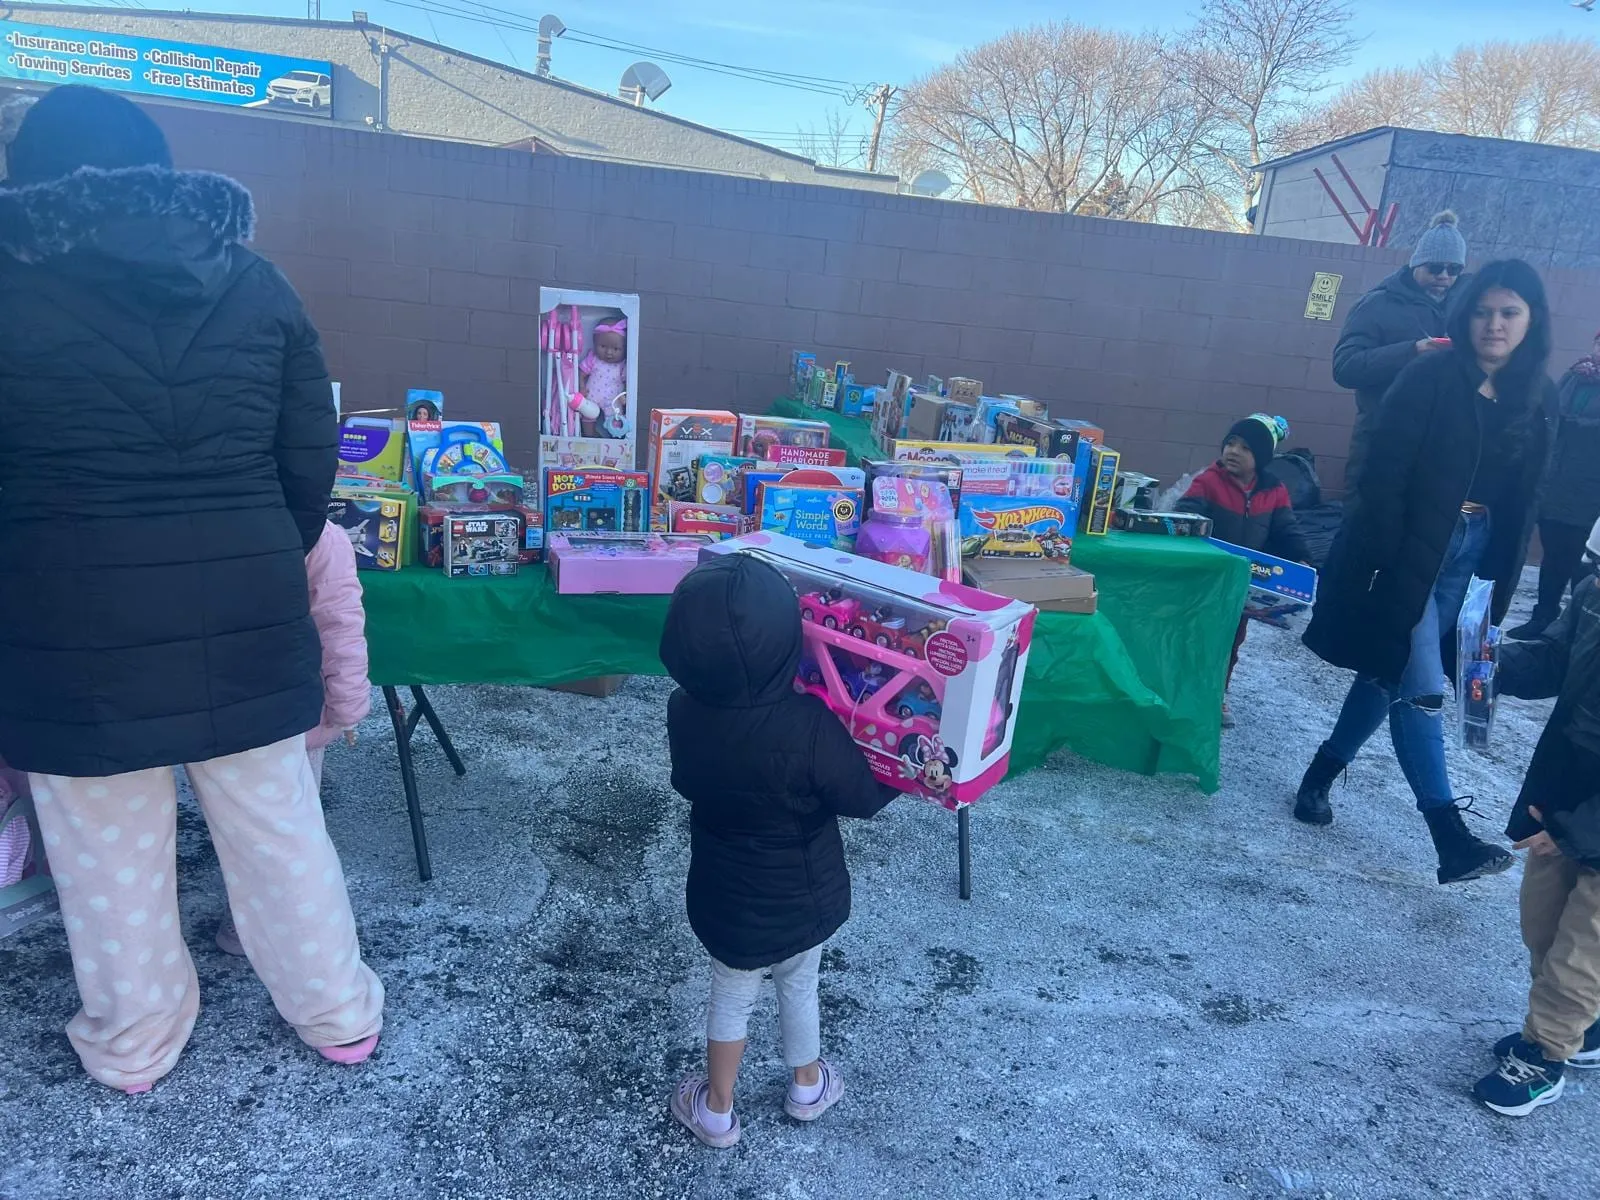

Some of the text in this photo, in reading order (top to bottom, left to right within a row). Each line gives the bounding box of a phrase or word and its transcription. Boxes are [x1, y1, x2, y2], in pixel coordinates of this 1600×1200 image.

[14, 32, 137, 60] Insurance Claims
[15, 54, 131, 80] Towing Services
[151, 50, 260, 77] Collision Repair
[151, 71, 254, 96] Free Estimates
[1311, 293, 1333, 302] SMILE
[681, 424, 713, 436] VEX
[780, 447, 830, 459] HANDMADE
[780, 456, 829, 466] CHARLOTTE
[963, 465, 985, 474] make
[992, 465, 1008, 474] real
[553, 474, 575, 484] HOT
[551, 482, 576, 492] DOTS
[795, 509, 830, 524] Simple
[992, 510, 1021, 529] HOT
[465, 525, 488, 533] WARS
[796, 520, 829, 531] Words
[966, 634, 976, 643] 3+
